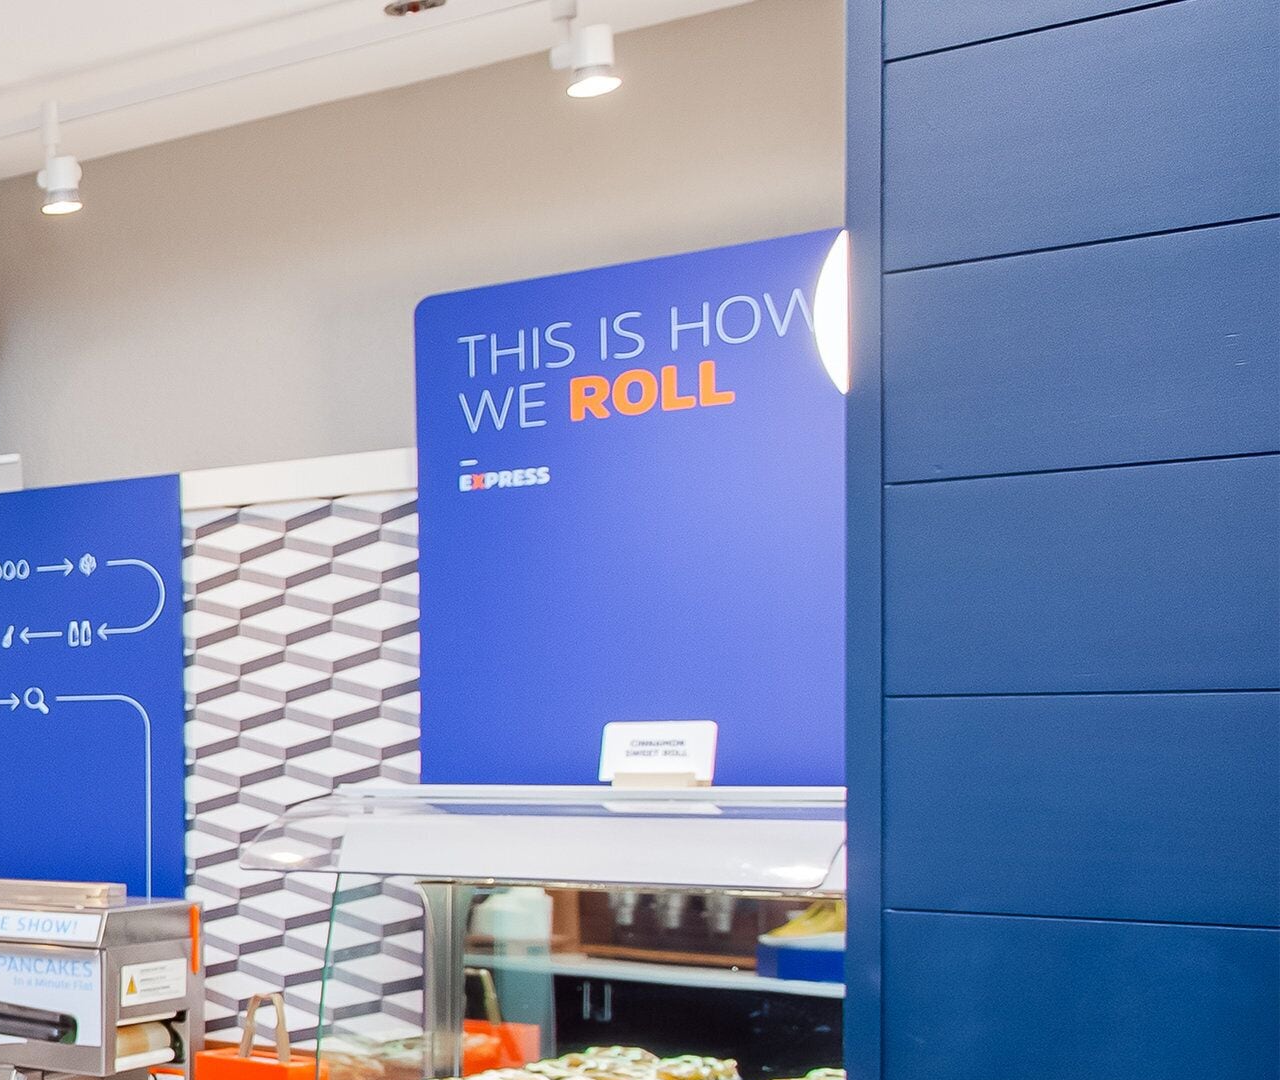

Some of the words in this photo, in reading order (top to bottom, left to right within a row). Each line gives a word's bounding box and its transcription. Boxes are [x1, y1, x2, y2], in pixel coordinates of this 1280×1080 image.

[457, 321, 576, 377] THIS
[600, 311, 645, 361] IS
[671, 288, 814, 351] HOW
[458, 382, 546, 434] WE
[570, 360, 735, 421] ROLL
[459, 466, 550, 492] EXPRESS
[17, 917, 79, 934] SHOW!
